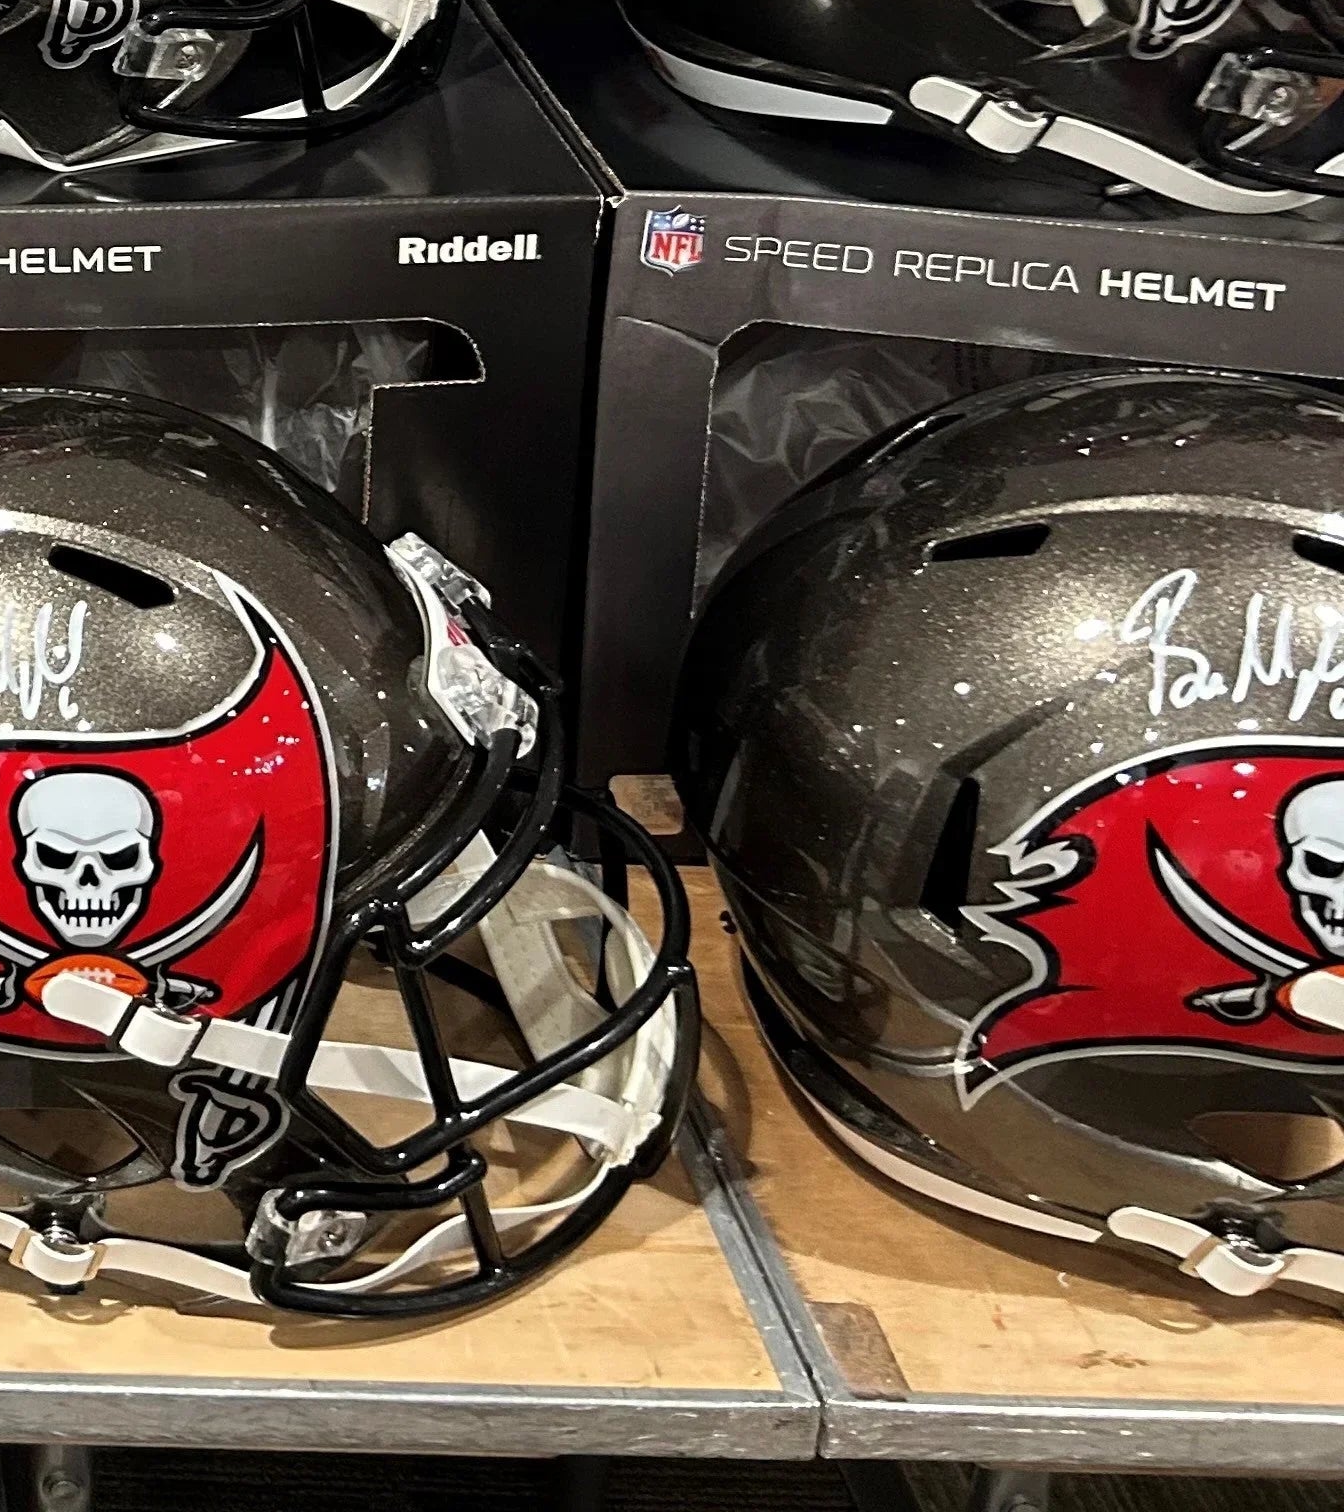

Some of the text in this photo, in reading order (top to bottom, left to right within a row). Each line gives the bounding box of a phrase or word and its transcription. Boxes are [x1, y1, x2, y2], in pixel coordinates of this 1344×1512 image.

[398, 233, 542, 265] Riddell
[653, 234, 700, 263] NFL
[724, 236, 1287, 312] SPEED REPLICA HELMET
